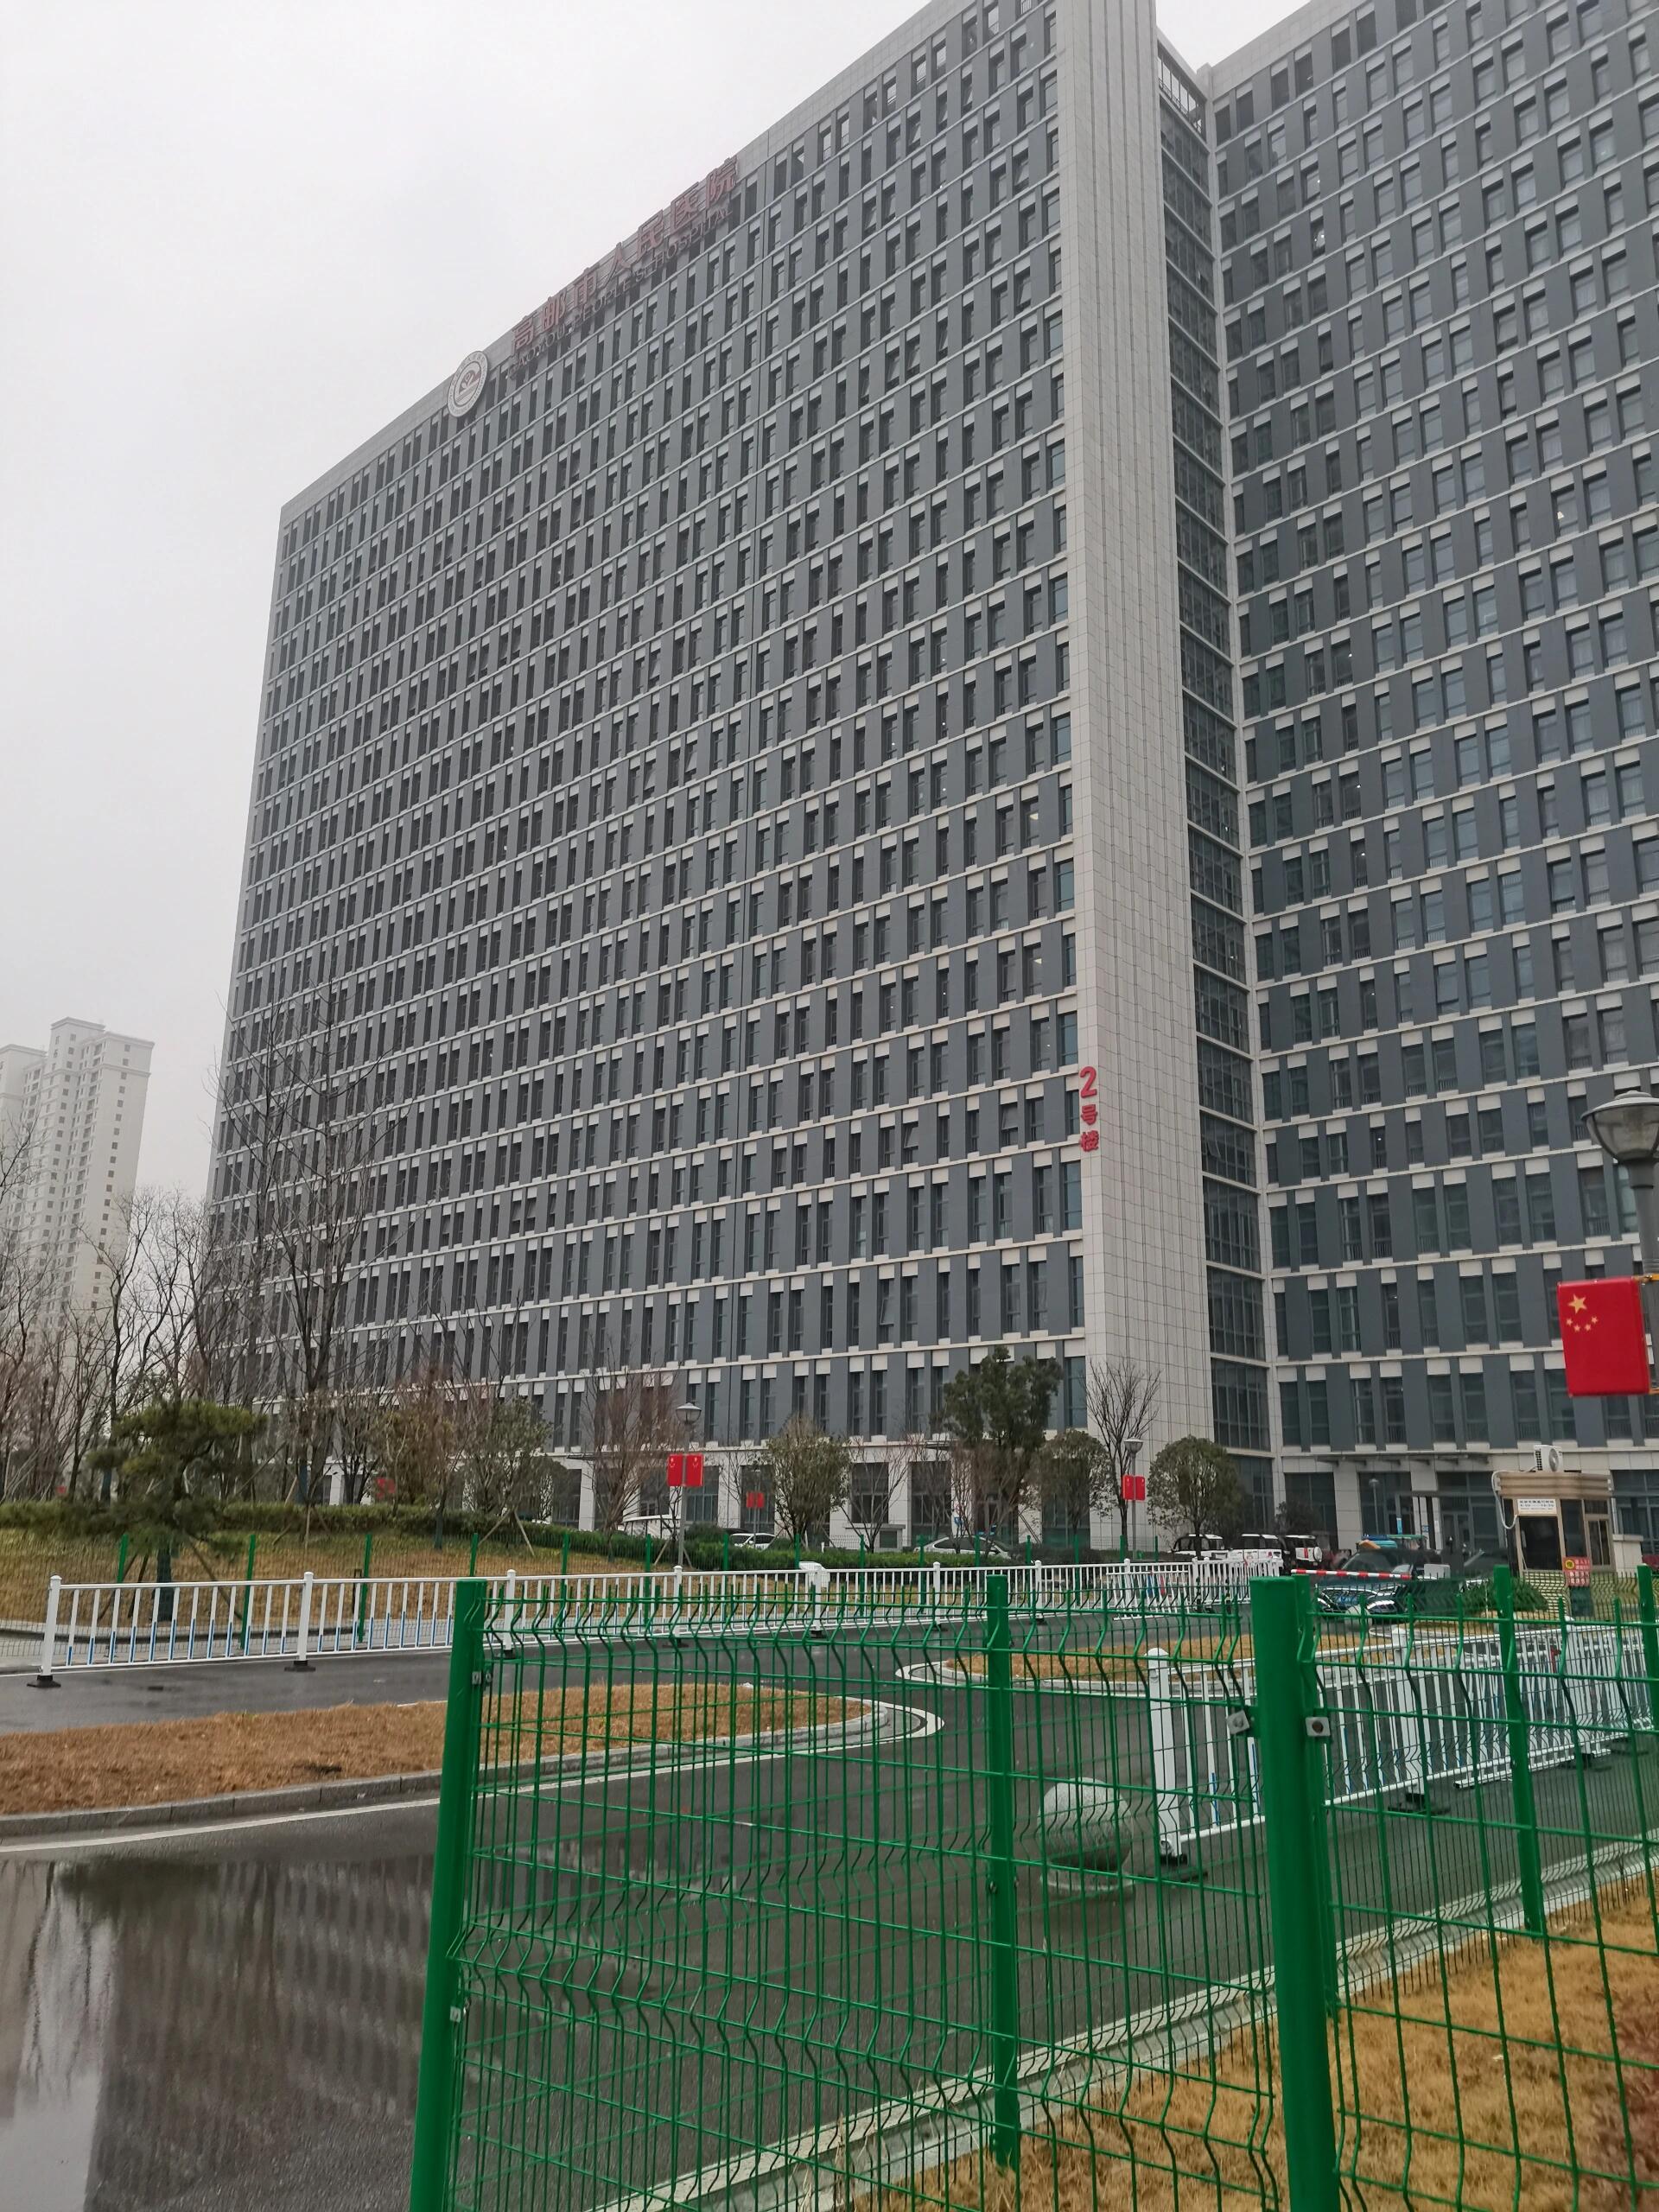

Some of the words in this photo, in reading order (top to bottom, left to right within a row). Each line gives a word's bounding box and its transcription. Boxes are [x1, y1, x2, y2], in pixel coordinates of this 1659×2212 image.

[512, 156, 737, 357] 高邮市人民医院
[654, 207, 734, 266] HOSPITAL
[1080, 1066, 1099, 1153] 2号楼
